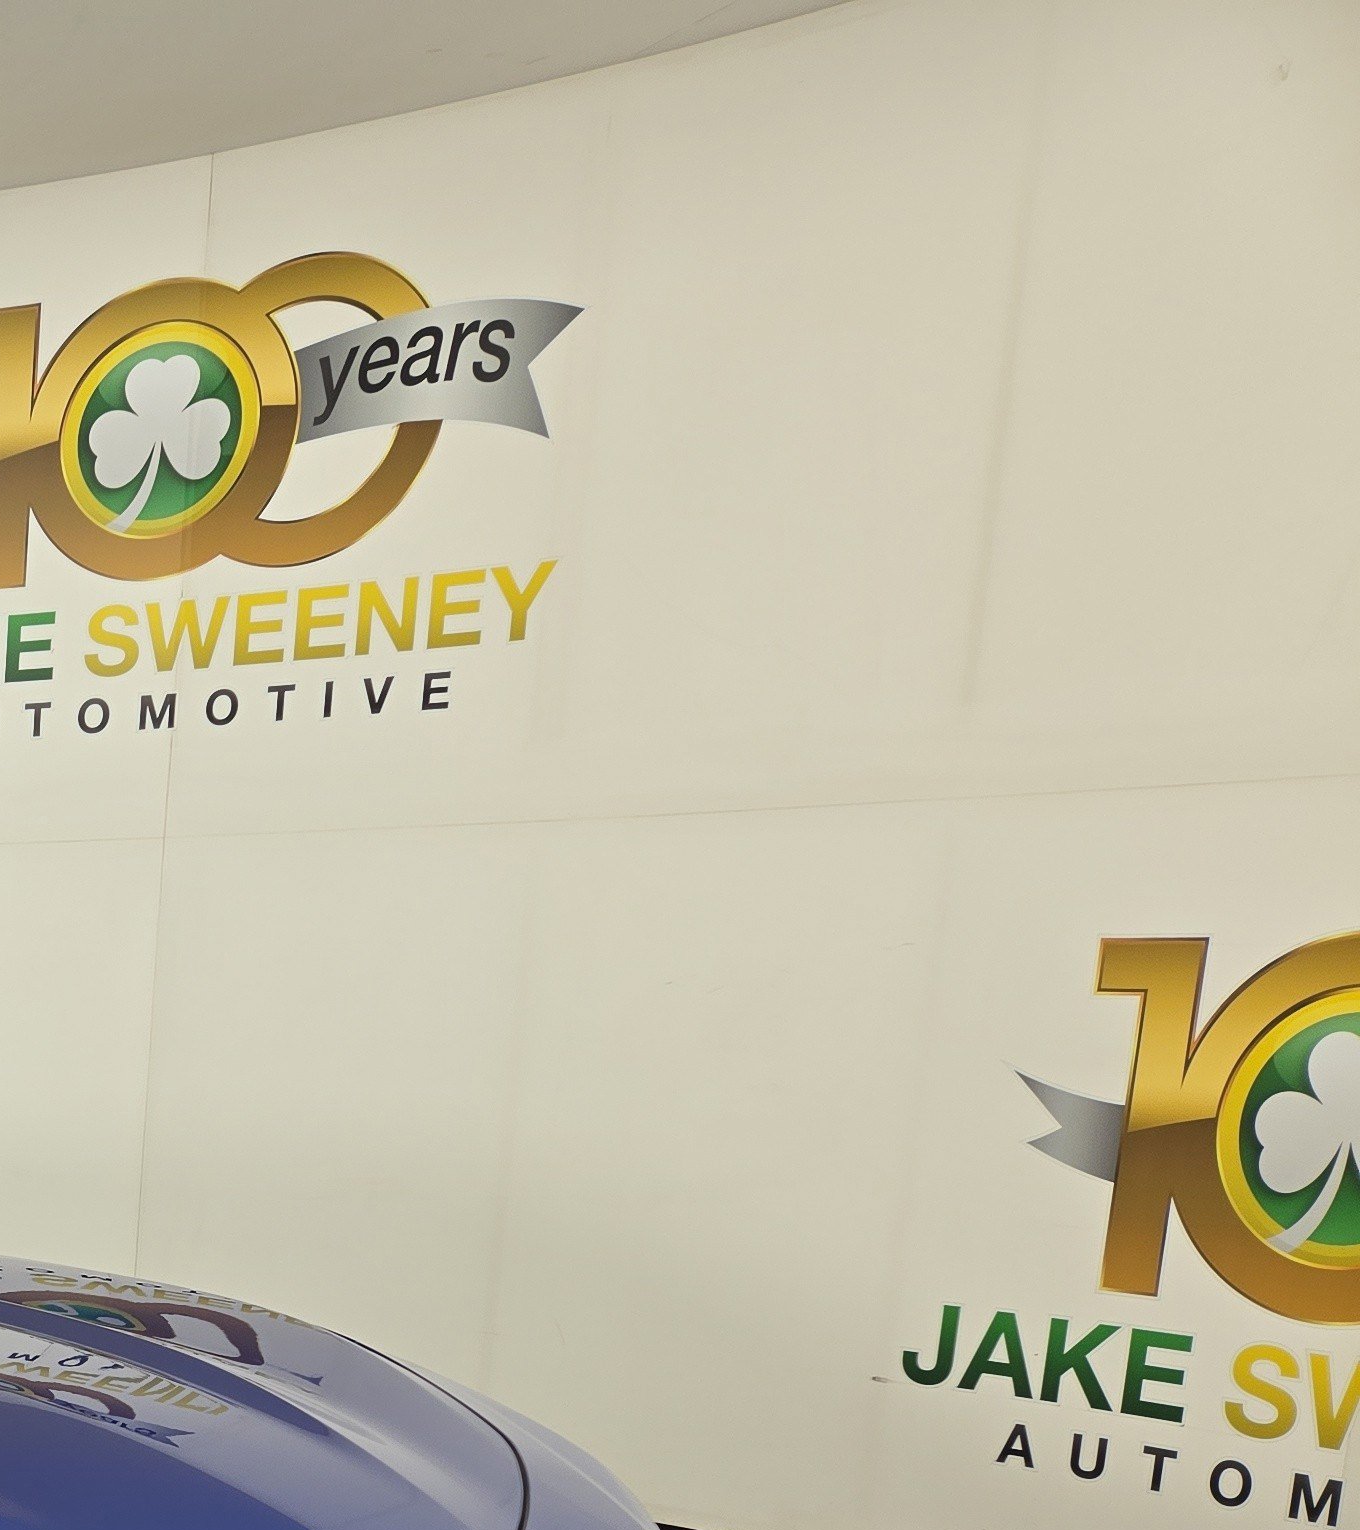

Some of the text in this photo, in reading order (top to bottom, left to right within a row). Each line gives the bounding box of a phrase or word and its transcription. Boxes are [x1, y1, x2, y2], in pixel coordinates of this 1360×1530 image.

[312, 317, 516, 427] years
[83, 560, 560, 678] SWEENEY
[902, 1304, 1194, 1425] JAKE
[996, 1423, 1344, 1527] AUTOM
